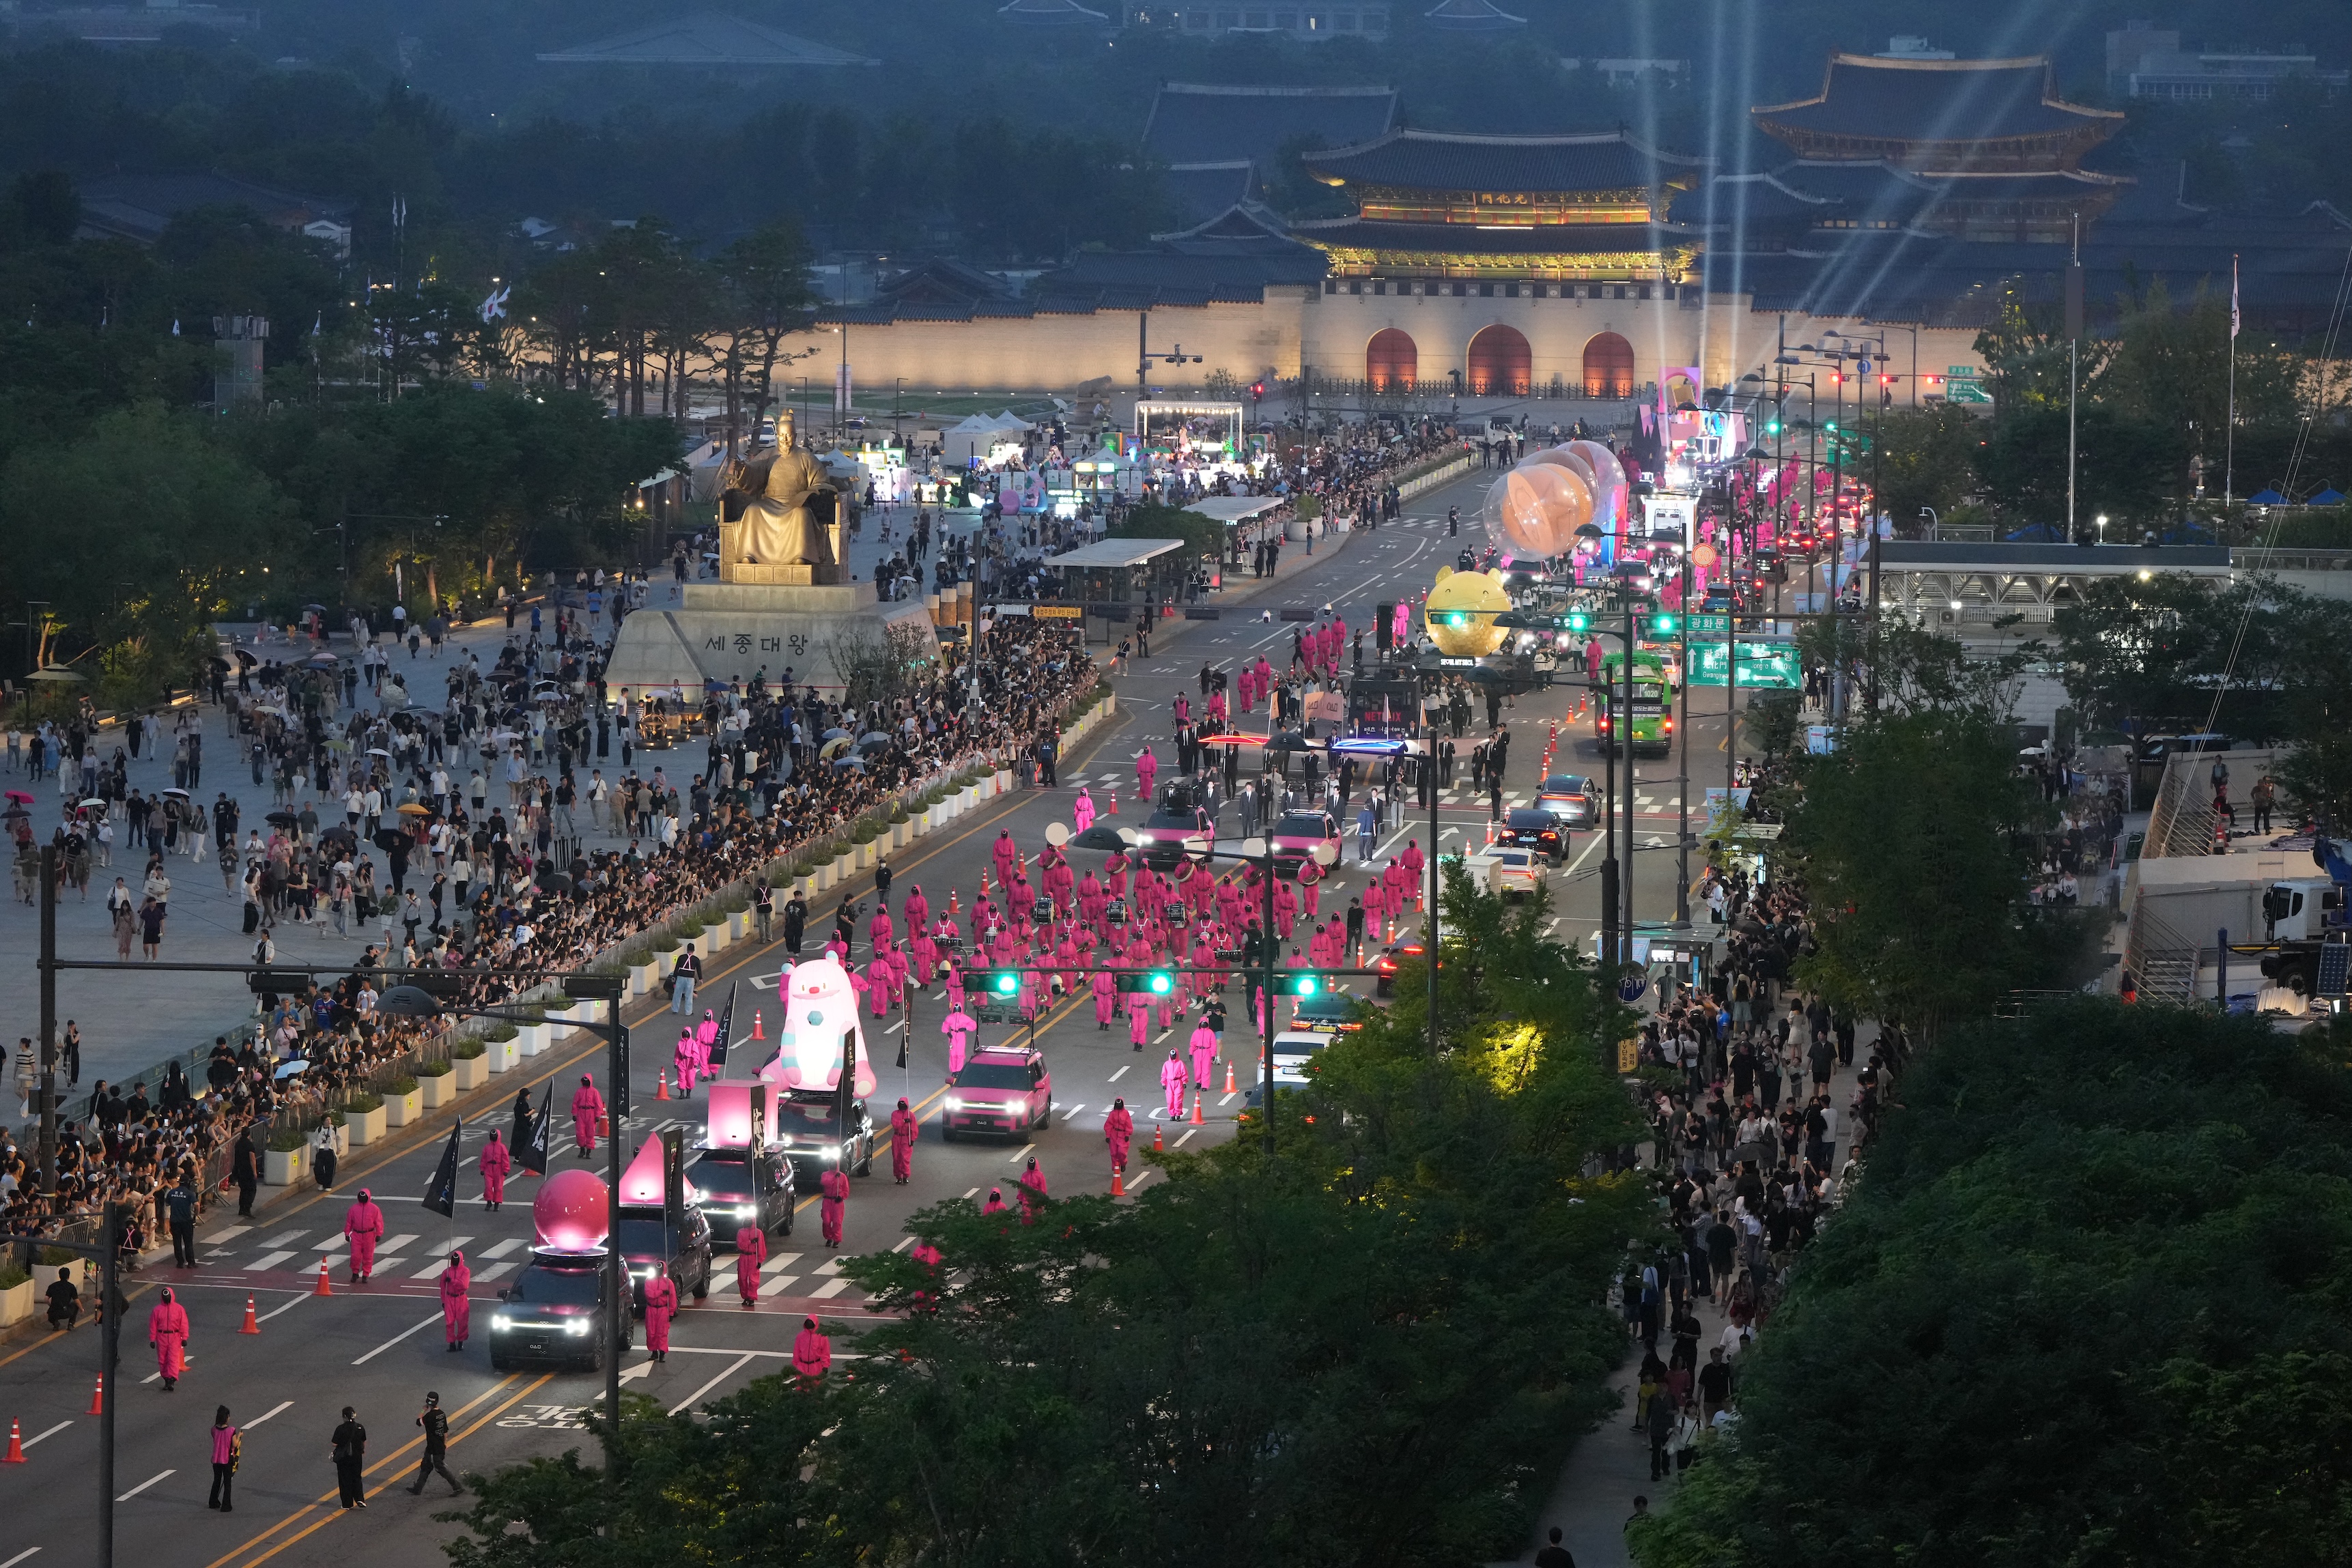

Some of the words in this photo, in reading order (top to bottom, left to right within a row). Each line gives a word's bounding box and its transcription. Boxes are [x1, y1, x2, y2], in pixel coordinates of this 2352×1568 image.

[1697, 550, 1711, 562] 50
[1691, 618, 1725, 629] 광화문
[705, 633, 808, 656] 세종대왕
[1751, 662, 1769, 670] Jongo
[1702, 671, 1739, 680] Gwanghwan
[1364, 711, 1402, 722] NETIX
